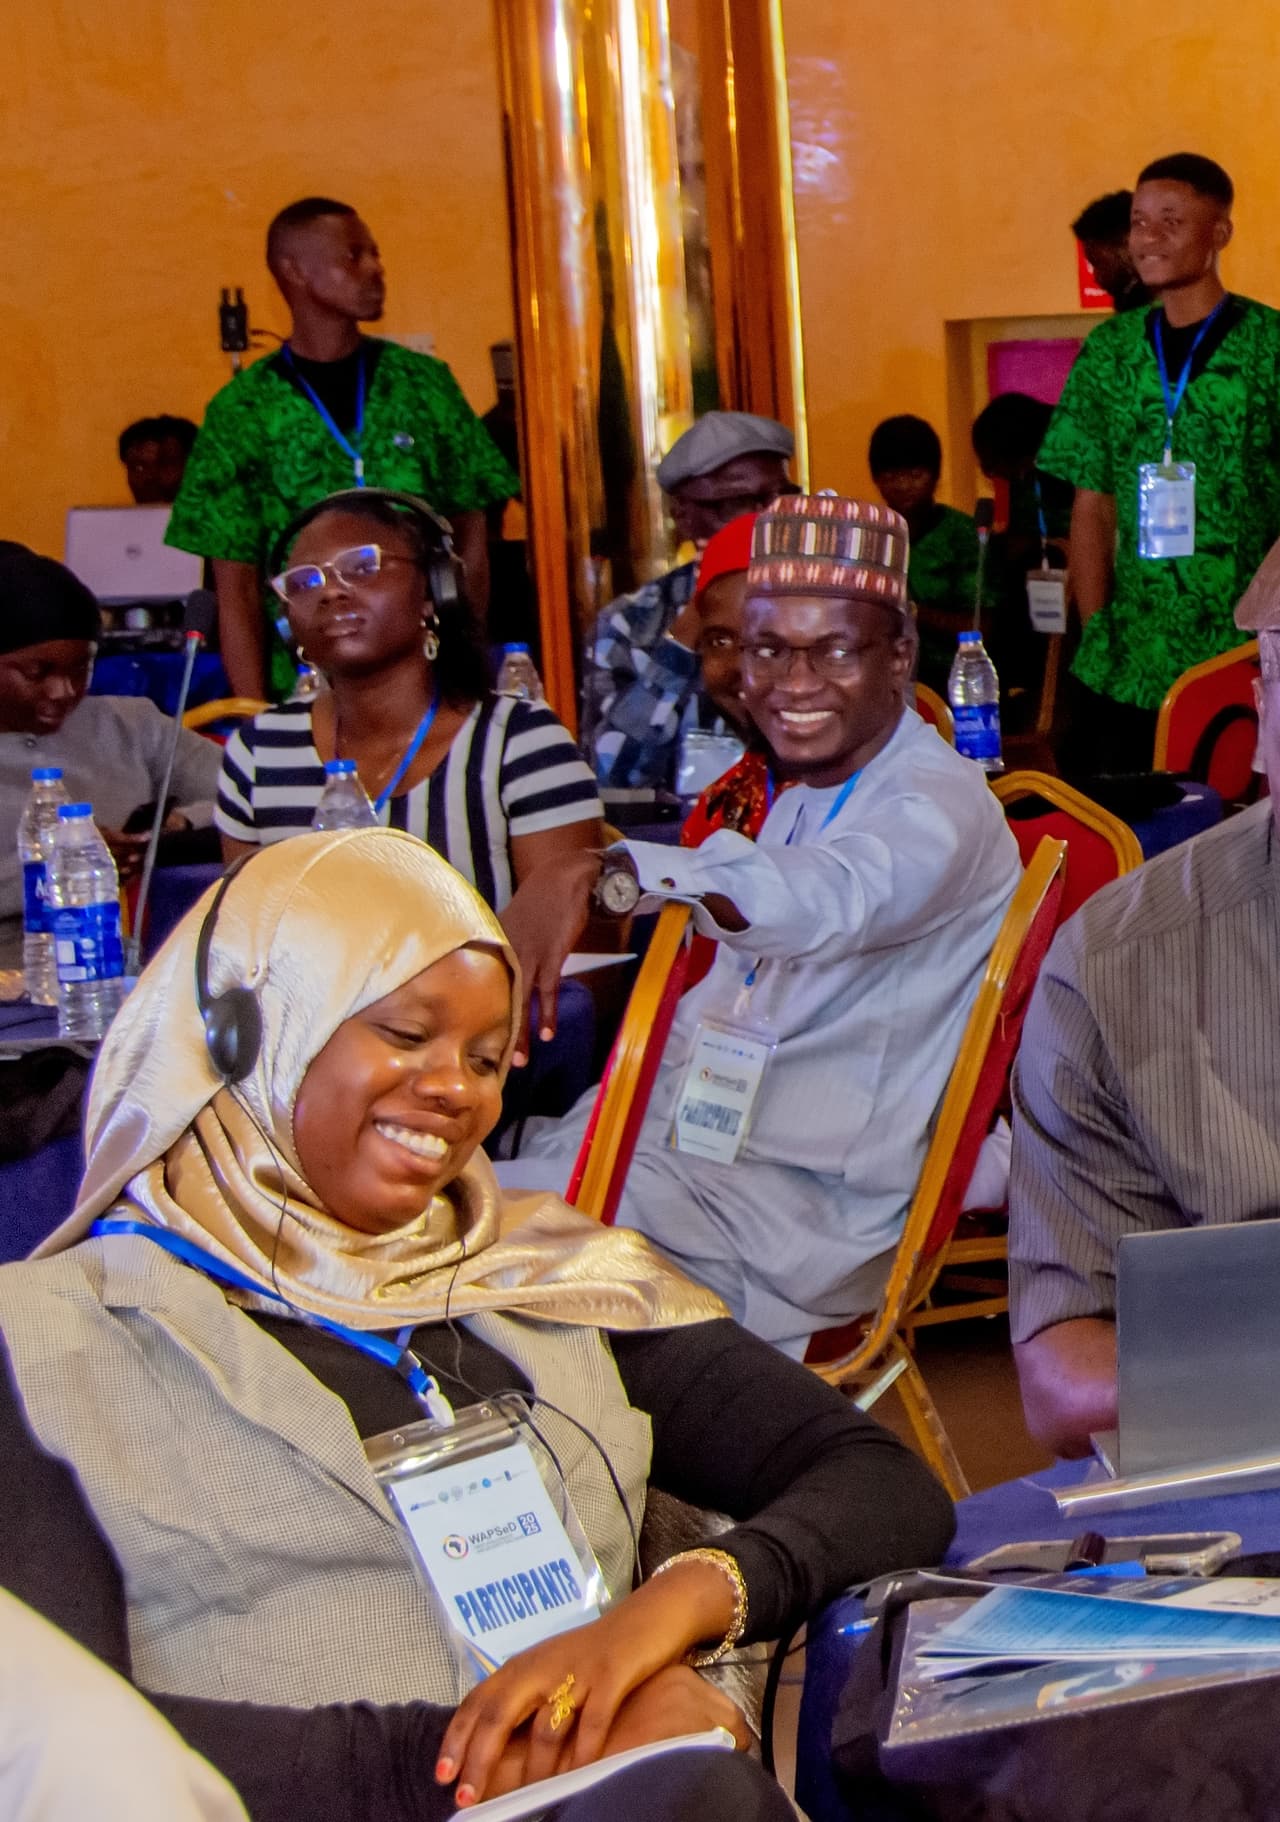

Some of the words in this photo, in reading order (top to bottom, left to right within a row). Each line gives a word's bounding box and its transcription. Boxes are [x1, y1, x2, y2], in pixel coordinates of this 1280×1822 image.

[468, 1520, 518, 1546] WAPSeD
[520, 1513, 536, 1527] 20
[525, 1523, 540, 1538] 25
[453, 1557, 583, 1638] PARTICIPANTS
